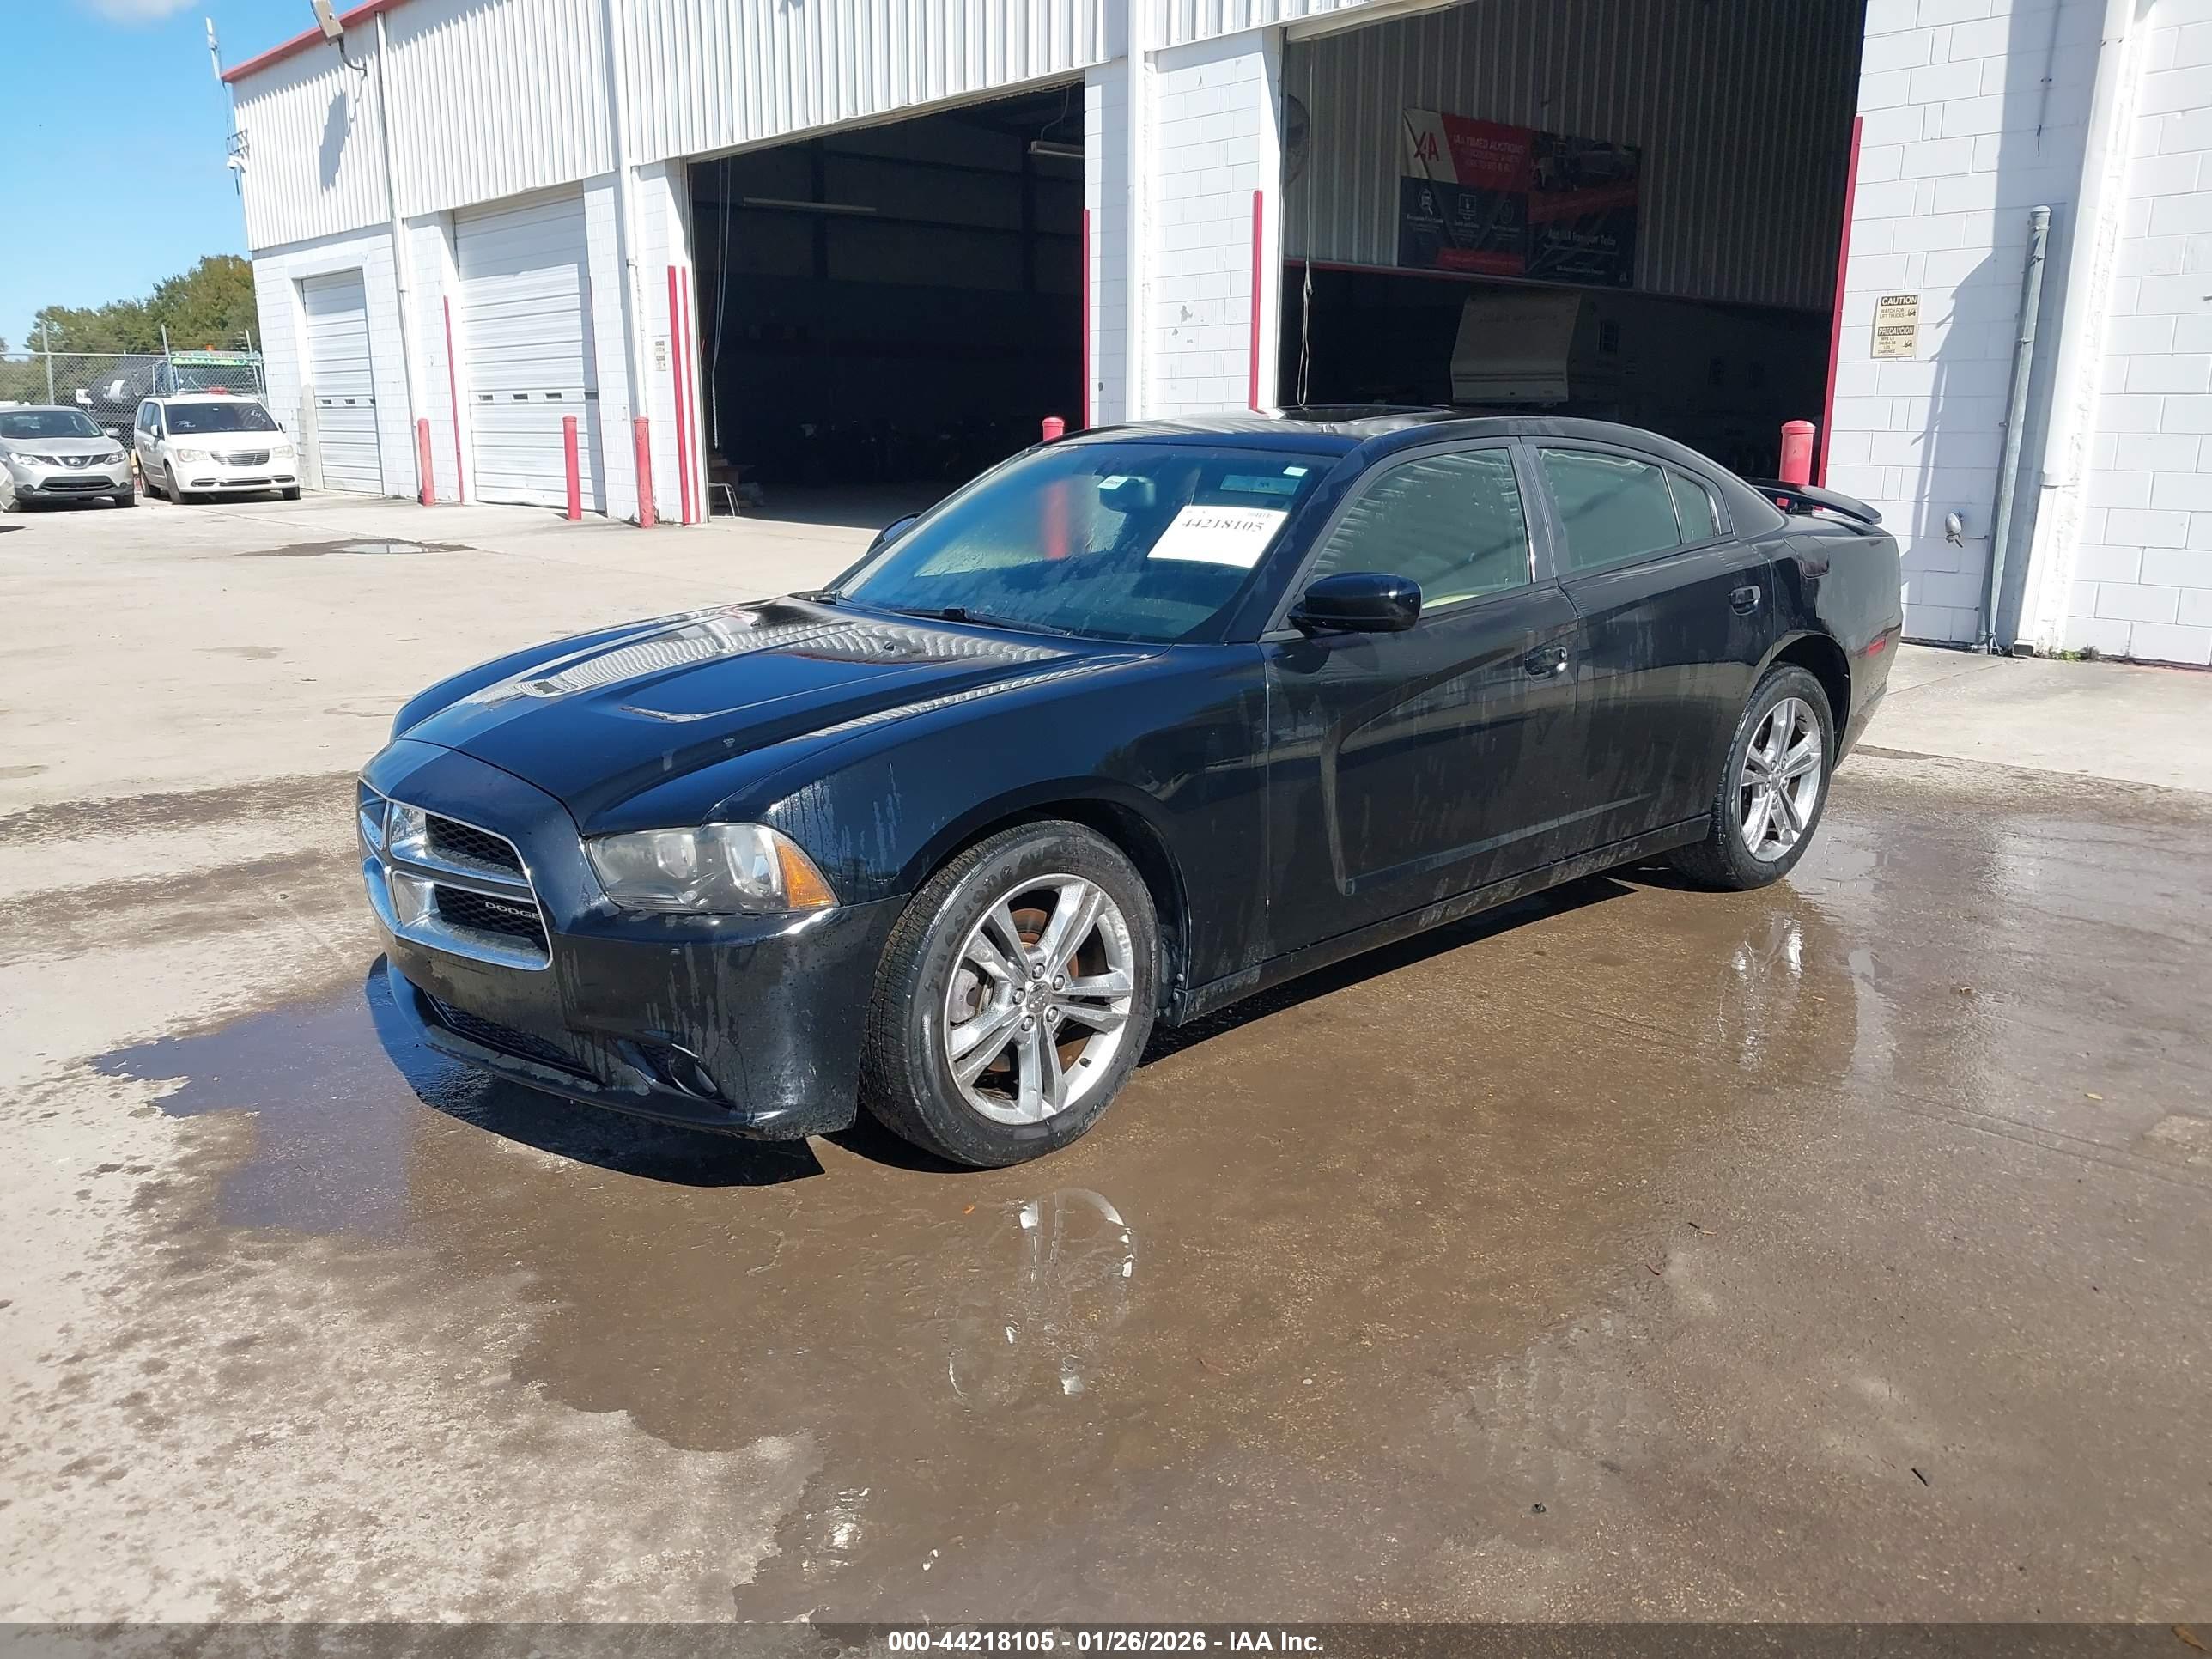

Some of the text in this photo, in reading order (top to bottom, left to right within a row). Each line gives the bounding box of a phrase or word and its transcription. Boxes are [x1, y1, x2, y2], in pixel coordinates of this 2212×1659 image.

[1489, 140, 1524, 155] AUCTIONS
[1882, 296, 1917, 305] CAUTION
[1879, 326, 1913, 336] PRECAUCION
[1182, 518, 1264, 532] 44218105
[484, 901, 541, 921] DODGE
